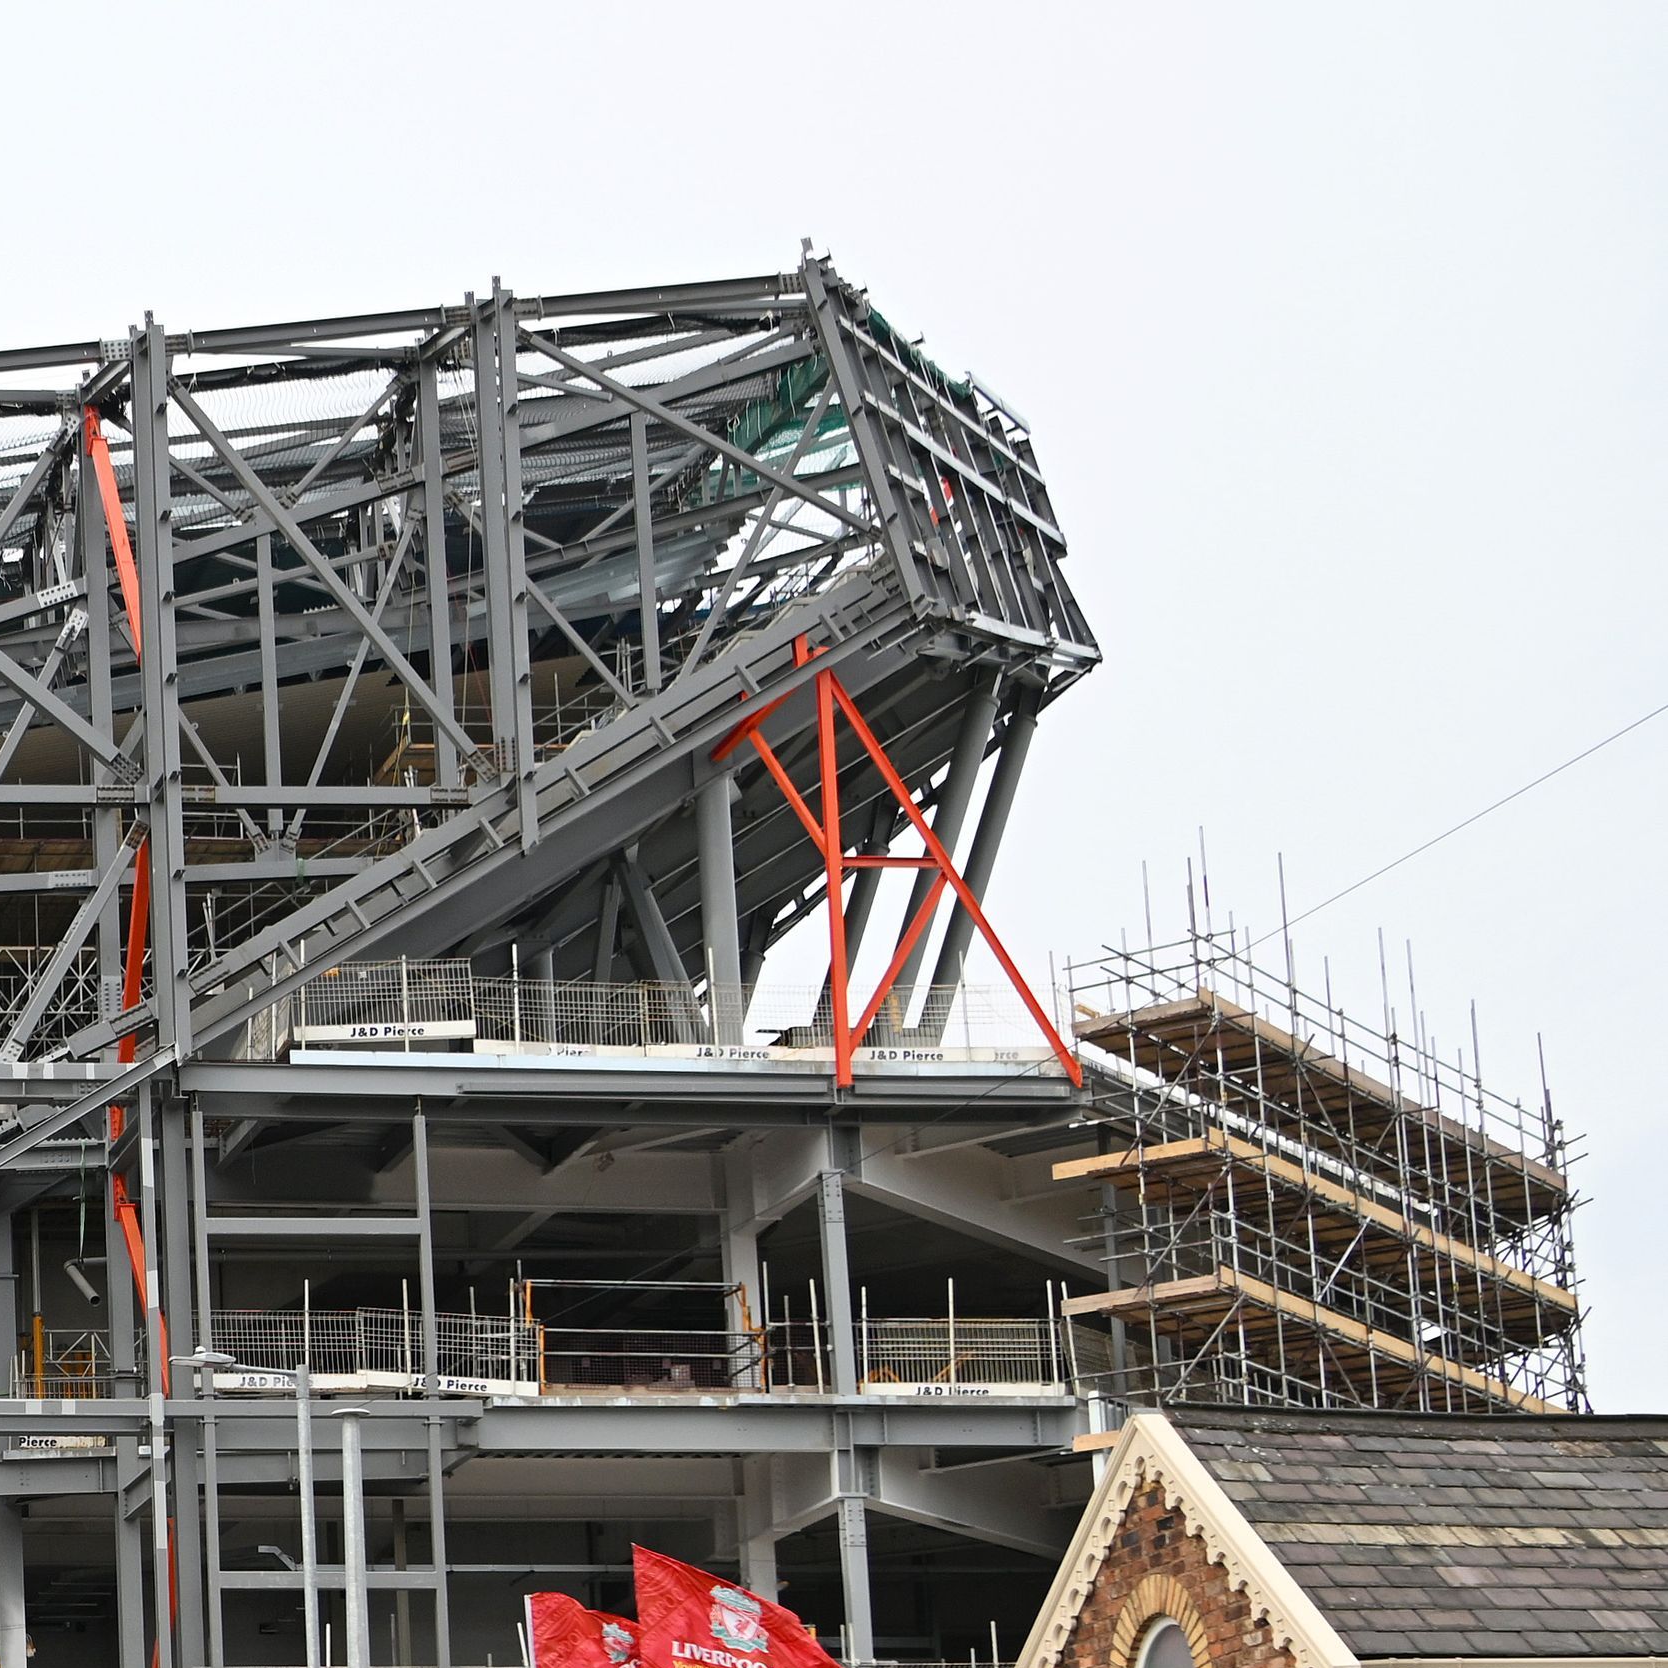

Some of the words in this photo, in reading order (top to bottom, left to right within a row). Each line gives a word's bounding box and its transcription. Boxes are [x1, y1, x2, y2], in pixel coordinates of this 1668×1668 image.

[729, 1048, 770, 1060] Pierce
[870, 1050, 898, 1061] J&D
[902, 1051, 944, 1062] Pierce
[239, 1376, 268, 1387] J&D
[446, 1379, 488, 1392] Pierce
[18, 1436, 58, 1448] Pierce
